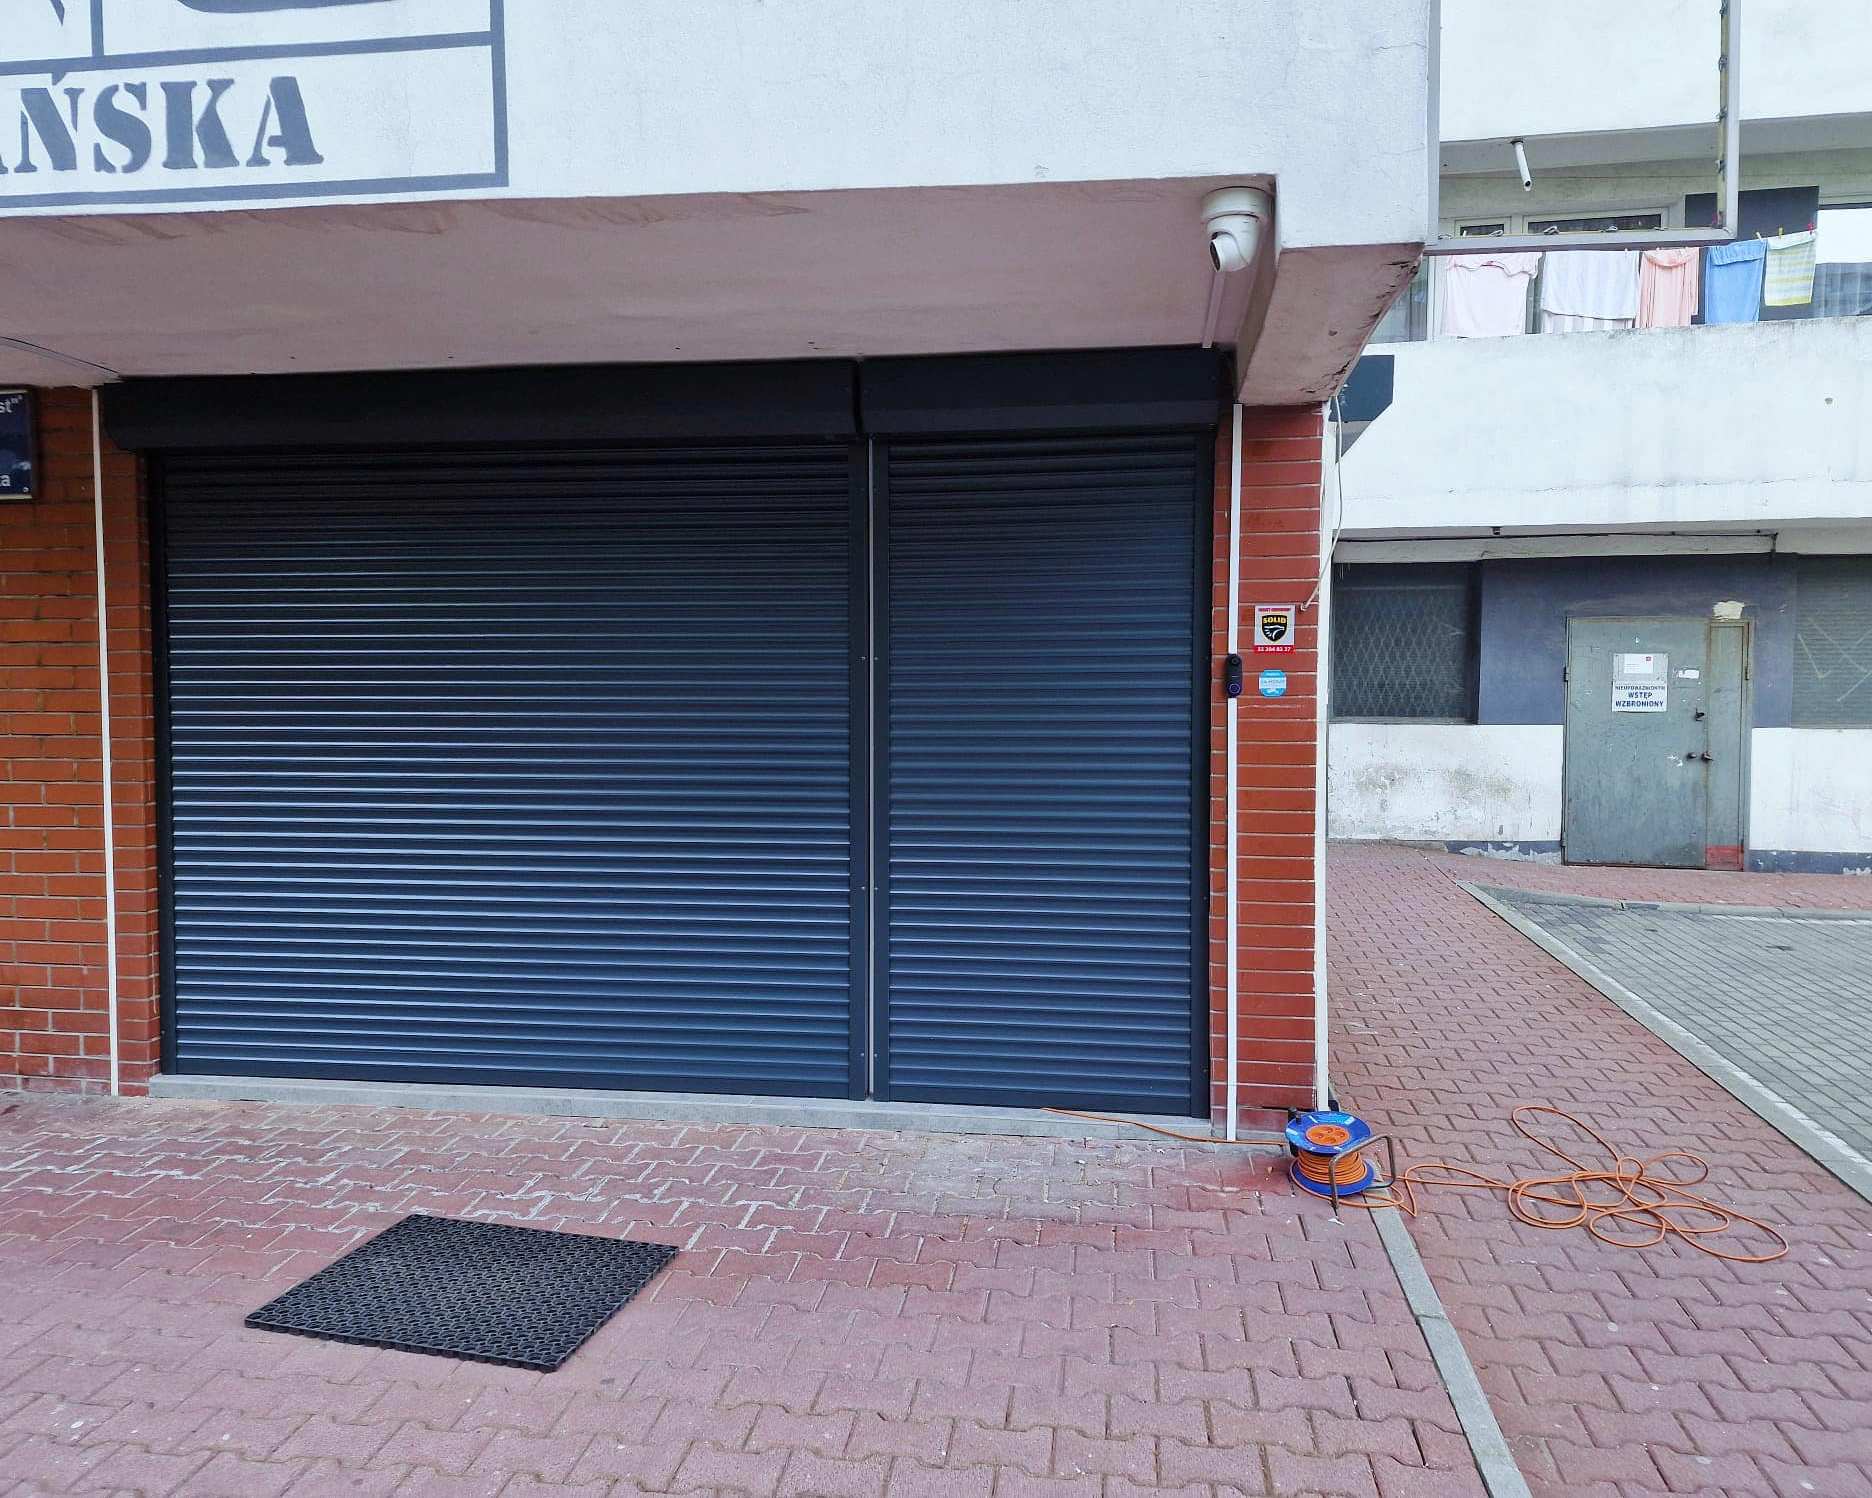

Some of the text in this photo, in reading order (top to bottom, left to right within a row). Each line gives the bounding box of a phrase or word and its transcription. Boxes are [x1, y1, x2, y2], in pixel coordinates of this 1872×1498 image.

[0, 72, 324, 174] ŃSKA
[1263, 616, 1286, 624] SOLID
[1628, 691, 1653, 699] WSTĘP
[1615, 700, 1664, 708] WZBRONIONY
